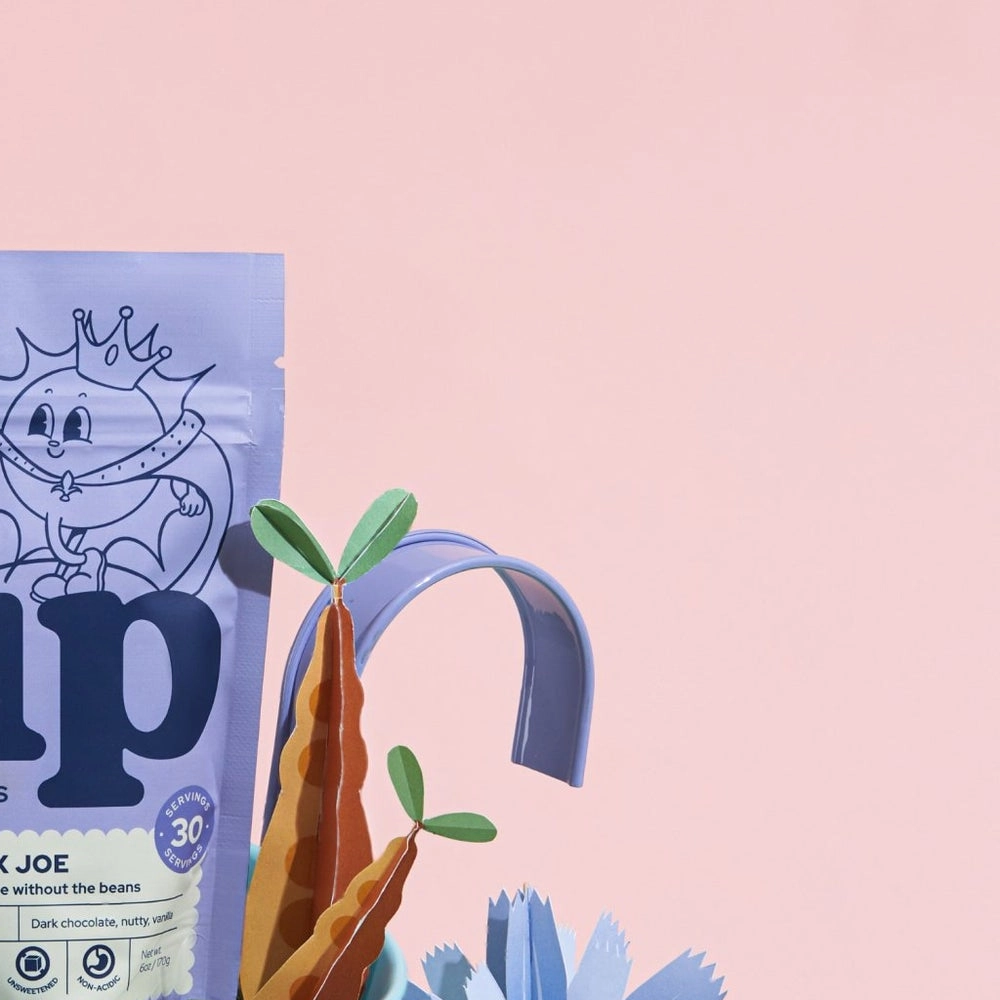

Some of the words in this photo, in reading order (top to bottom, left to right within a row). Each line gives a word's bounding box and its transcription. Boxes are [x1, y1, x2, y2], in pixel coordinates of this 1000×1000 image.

[165, 791, 211, 818] SERVINGS
[170, 815, 204, 848] 30
[15, 854, 70, 874] JOE
[12, 883, 69, 896] without
[72, 883, 96, 894] the
[99, 882, 142, 894] beans
[31, 918, 59, 929] Dark
[60, 916, 119, 929] chocolate,
[121, 915, 151, 927] nutty,
[7, 976, 59, 995] UNSWEETENED
[77, 975, 121, 992] NON-ACIDIC
